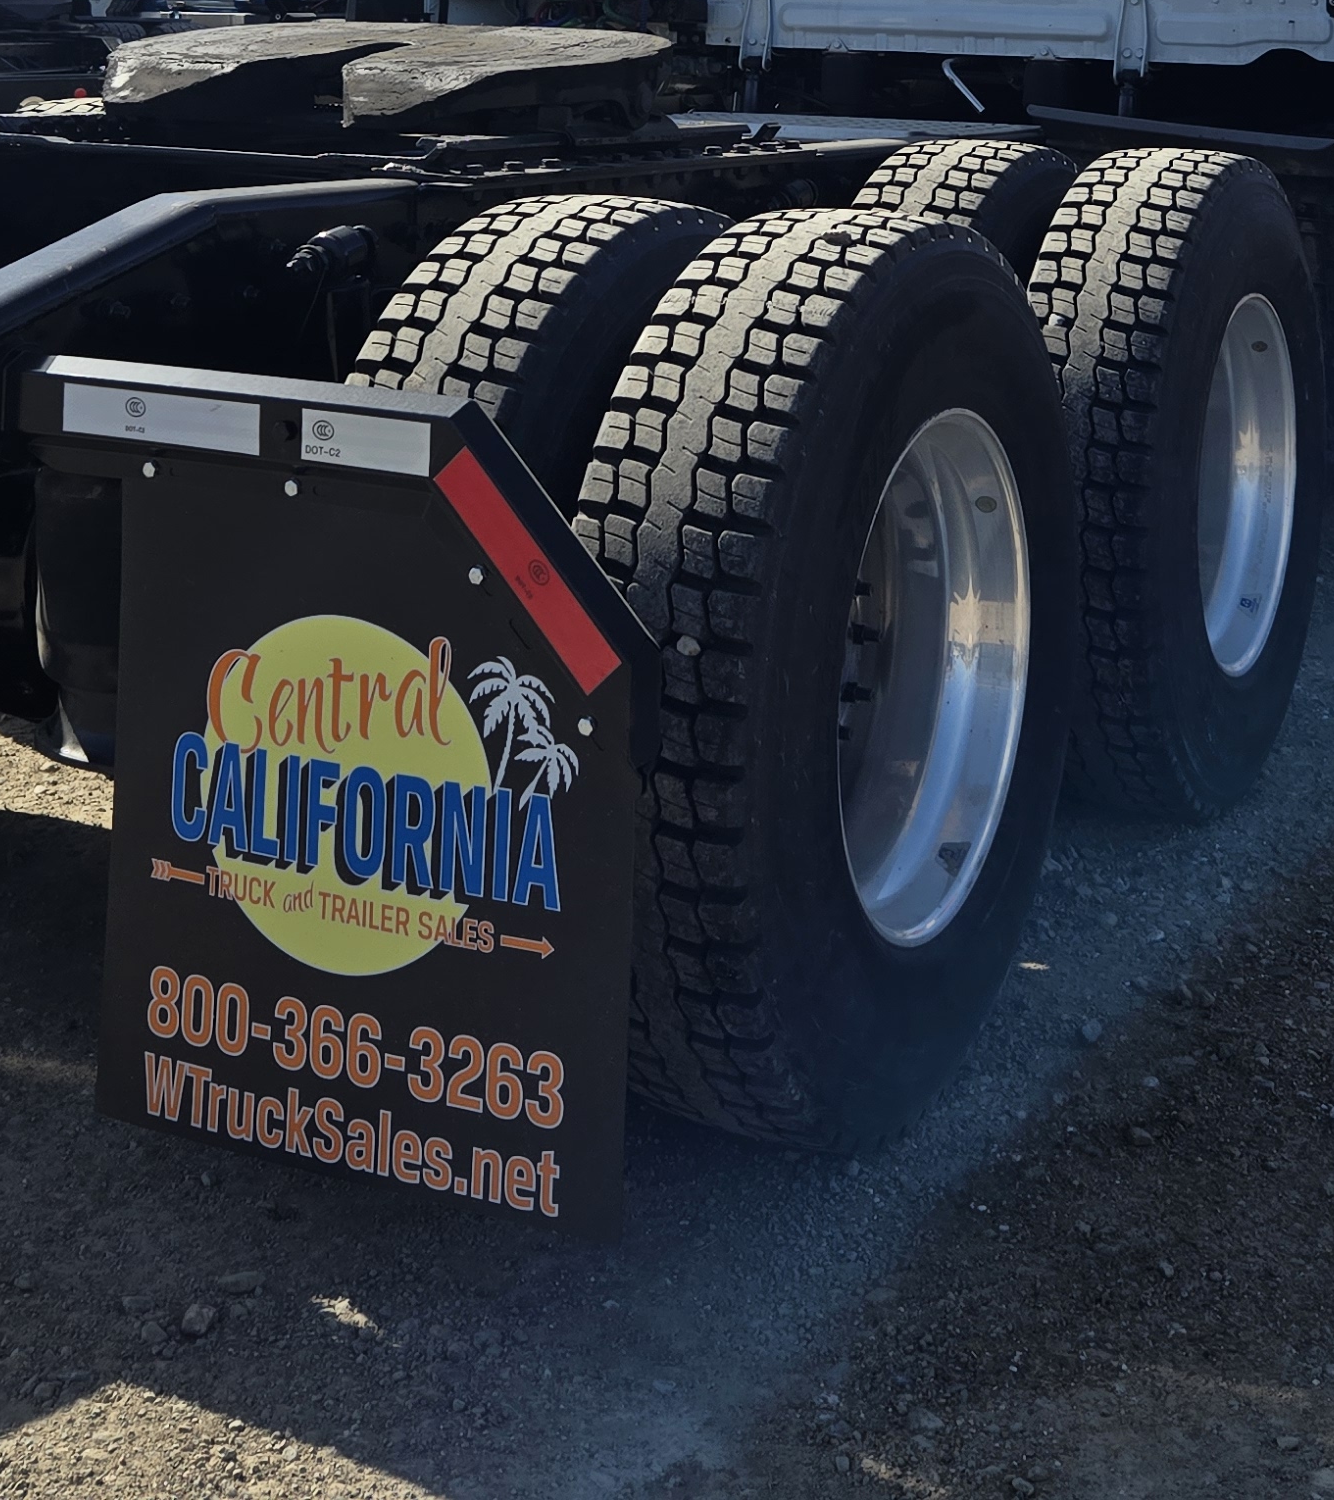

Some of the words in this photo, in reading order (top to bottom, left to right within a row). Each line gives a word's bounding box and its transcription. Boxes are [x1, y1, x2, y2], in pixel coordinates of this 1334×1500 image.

[305, 444, 342, 458] DOT-C2
[207, 636, 452, 754] Central
[171, 731, 561, 912] CALIFORNIA
[206, 865, 277, 909] TRUCK
[283, 880, 314, 914] and
[318, 890, 411, 938] TRAILER
[417, 911, 495, 954] SALES
[147, 965, 565, 1129] 800-366-3263
[144, 1051, 560, 1218] WTruckSales.net
